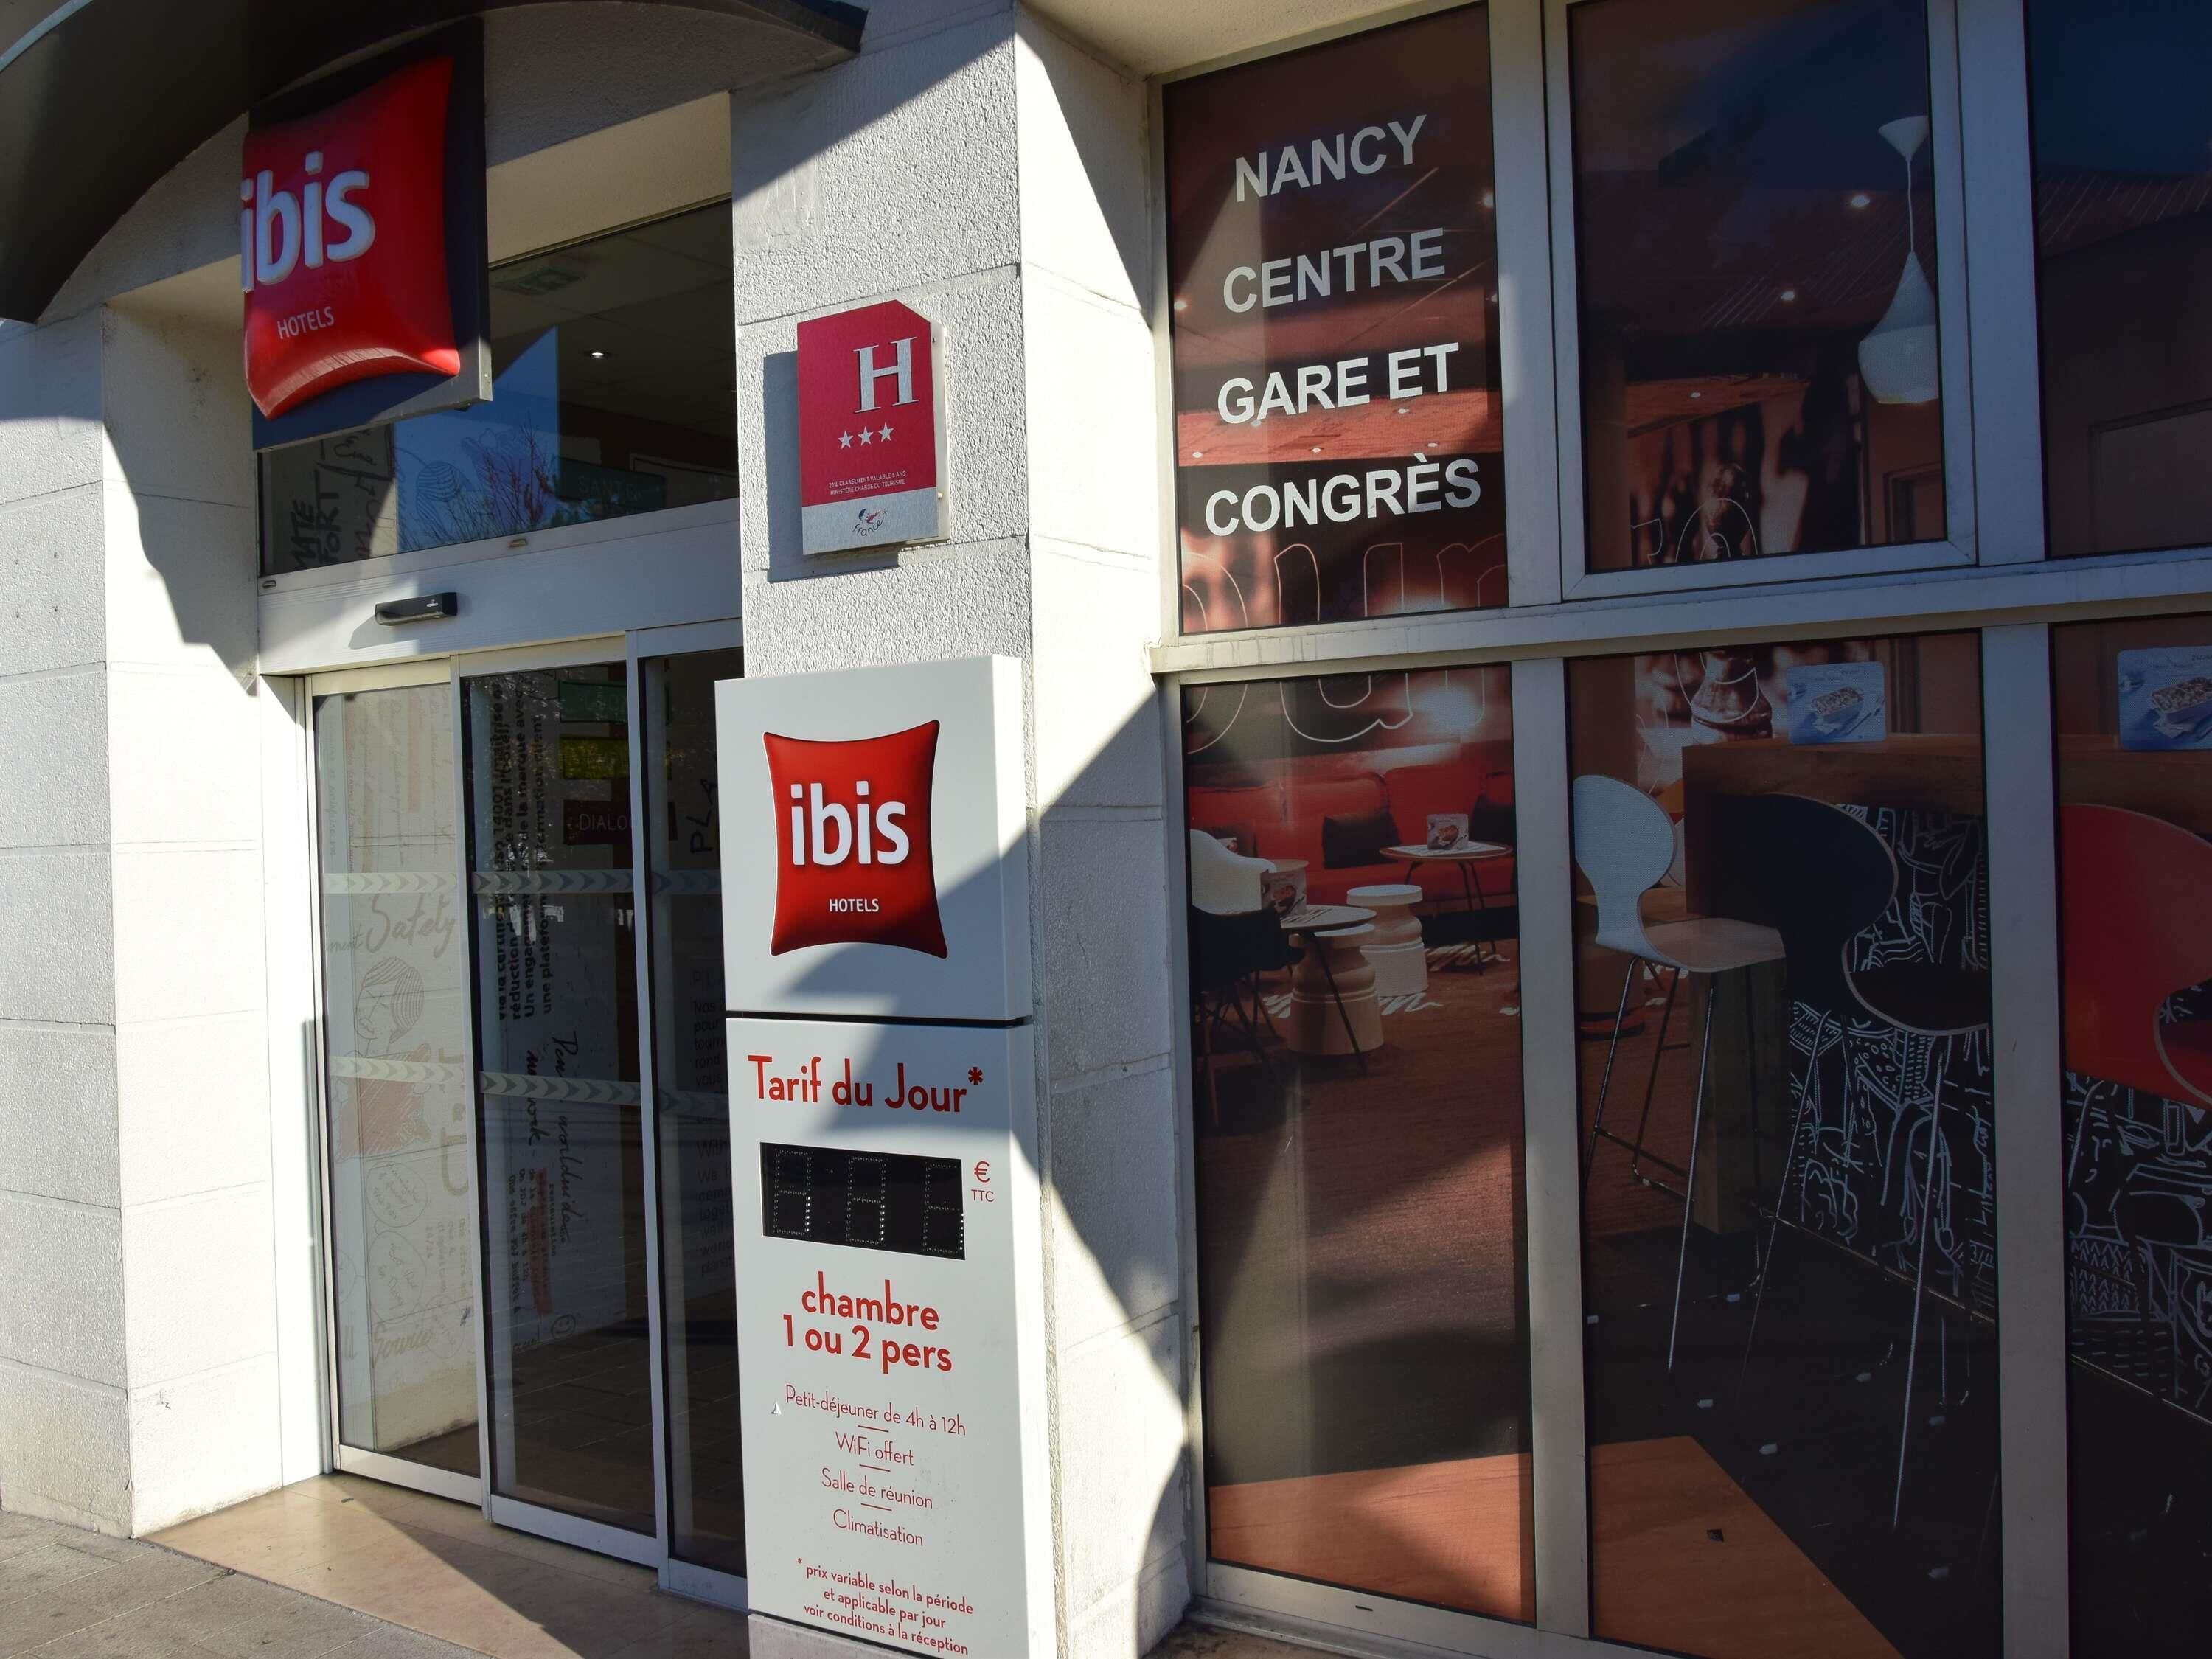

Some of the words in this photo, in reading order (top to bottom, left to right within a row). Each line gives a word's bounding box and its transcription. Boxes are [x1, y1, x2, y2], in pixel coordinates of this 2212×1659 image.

[1234, 114, 1427, 202] NANCY
[241, 150, 375, 294] ibis
[1223, 227, 1445, 313] CENTRE
[277, 306, 335, 339] HOTELS
[852, 336, 921, 414] H
[1217, 355, 1370, 425] GARE
[1388, 341, 1460, 400] ET
[839, 476, 870, 487] CLASSEMENT
[870, 473, 891, 481] VALABLE
[882, 479, 906, 487] TOURISME
[1205, 452, 1481, 536] CONGRÈS
[852, 518, 884, 536] france
[790, 780, 910, 867] ibis
[829, 898, 879, 913] HOTELS
[524, 993, 535, 1018] Un
[541, 983, 552, 1014] une
[748, 1054, 821, 1103] Tarif
[832, 1058, 872, 1107] du
[973, 1161, 990, 1183] €
[971, 1189, 994, 1203] TTC
[801, 1270, 939, 1331] chambre
[782, 1314, 793, 1347] 1
[804, 1329, 842, 1355] ou
[851, 1324, 872, 1360] 2
[880, 1338, 953, 1375] pers
[786, 1385, 878, 1420] Petit-déjeuner
[884, 1403, 901, 1424] de
[906, 1407, 924, 1429] 4h
[929, 1413, 936, 1431] à
[942, 1414, 966, 1436] 12h
[835, 1432, 870, 1458] WiFi
[875, 1441, 914, 1466] offert
[822, 1469, 855, 1492] Salle
[859, 1475, 875, 1497] de
[881, 1486, 933, 1509] réunion
[833, 1510, 923, 1545] Climatisation
[807, 1565, 827, 1580] prix
[831, 1568, 874, 1590] variable
[879, 1579, 909, 1599] selon
[911, 1587, 922, 1603] la
[926, 1592, 973, 1615] période
[824, 1589, 835, 1601] et
[838, 1591, 896, 1618] applicable
[900, 1608, 918, 1622] par
[921, 1611, 946, 1628] jour
[804, 1605, 822, 1618] voir
[827, 1609, 885, 1636] conditions
[888, 1624, 895, 1637] à
[897, 1624, 908, 1639] la
[911, 1630, 968, 1655] réception
